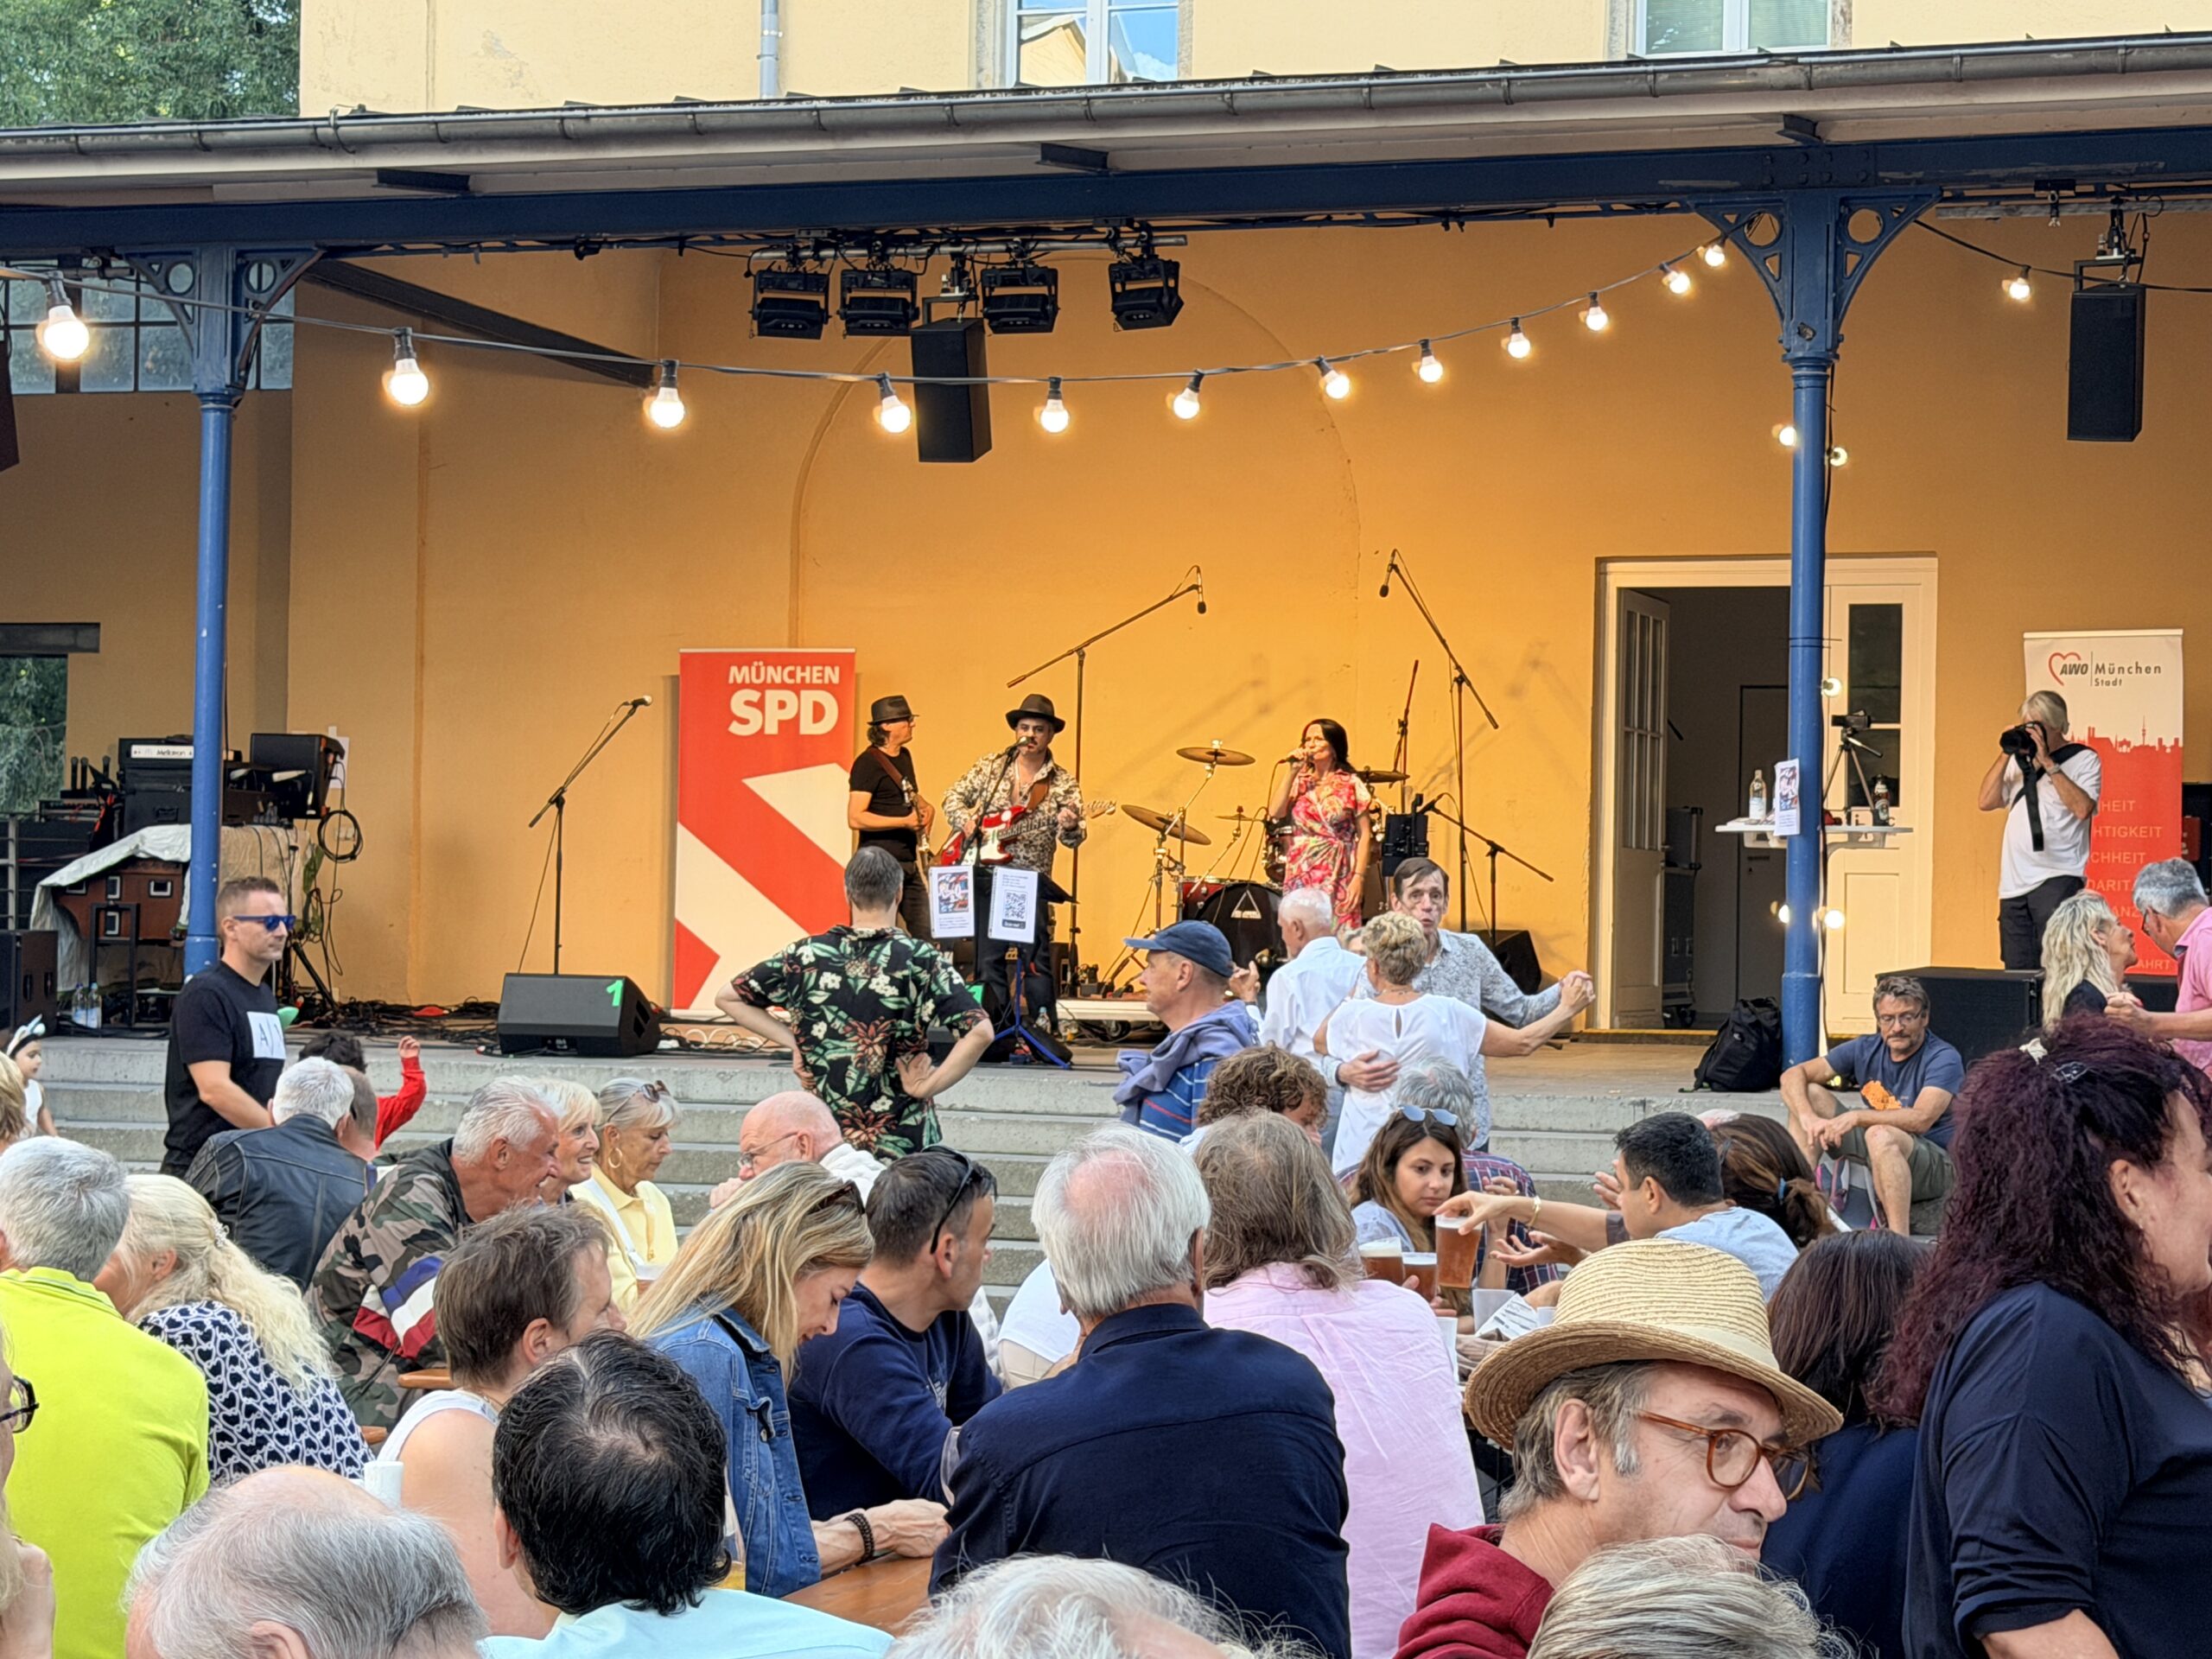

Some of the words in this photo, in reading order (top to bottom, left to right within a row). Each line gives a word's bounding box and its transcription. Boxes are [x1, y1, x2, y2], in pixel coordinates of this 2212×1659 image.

[728, 660, 840, 684] MÜNCHEN
[2060, 663, 2088, 675] AWO
[2094, 661, 2162, 675] München
[2094, 677, 2122, 687] Stadt
[728, 688, 839, 736] SPD
[607, 980, 623, 1007] 1
